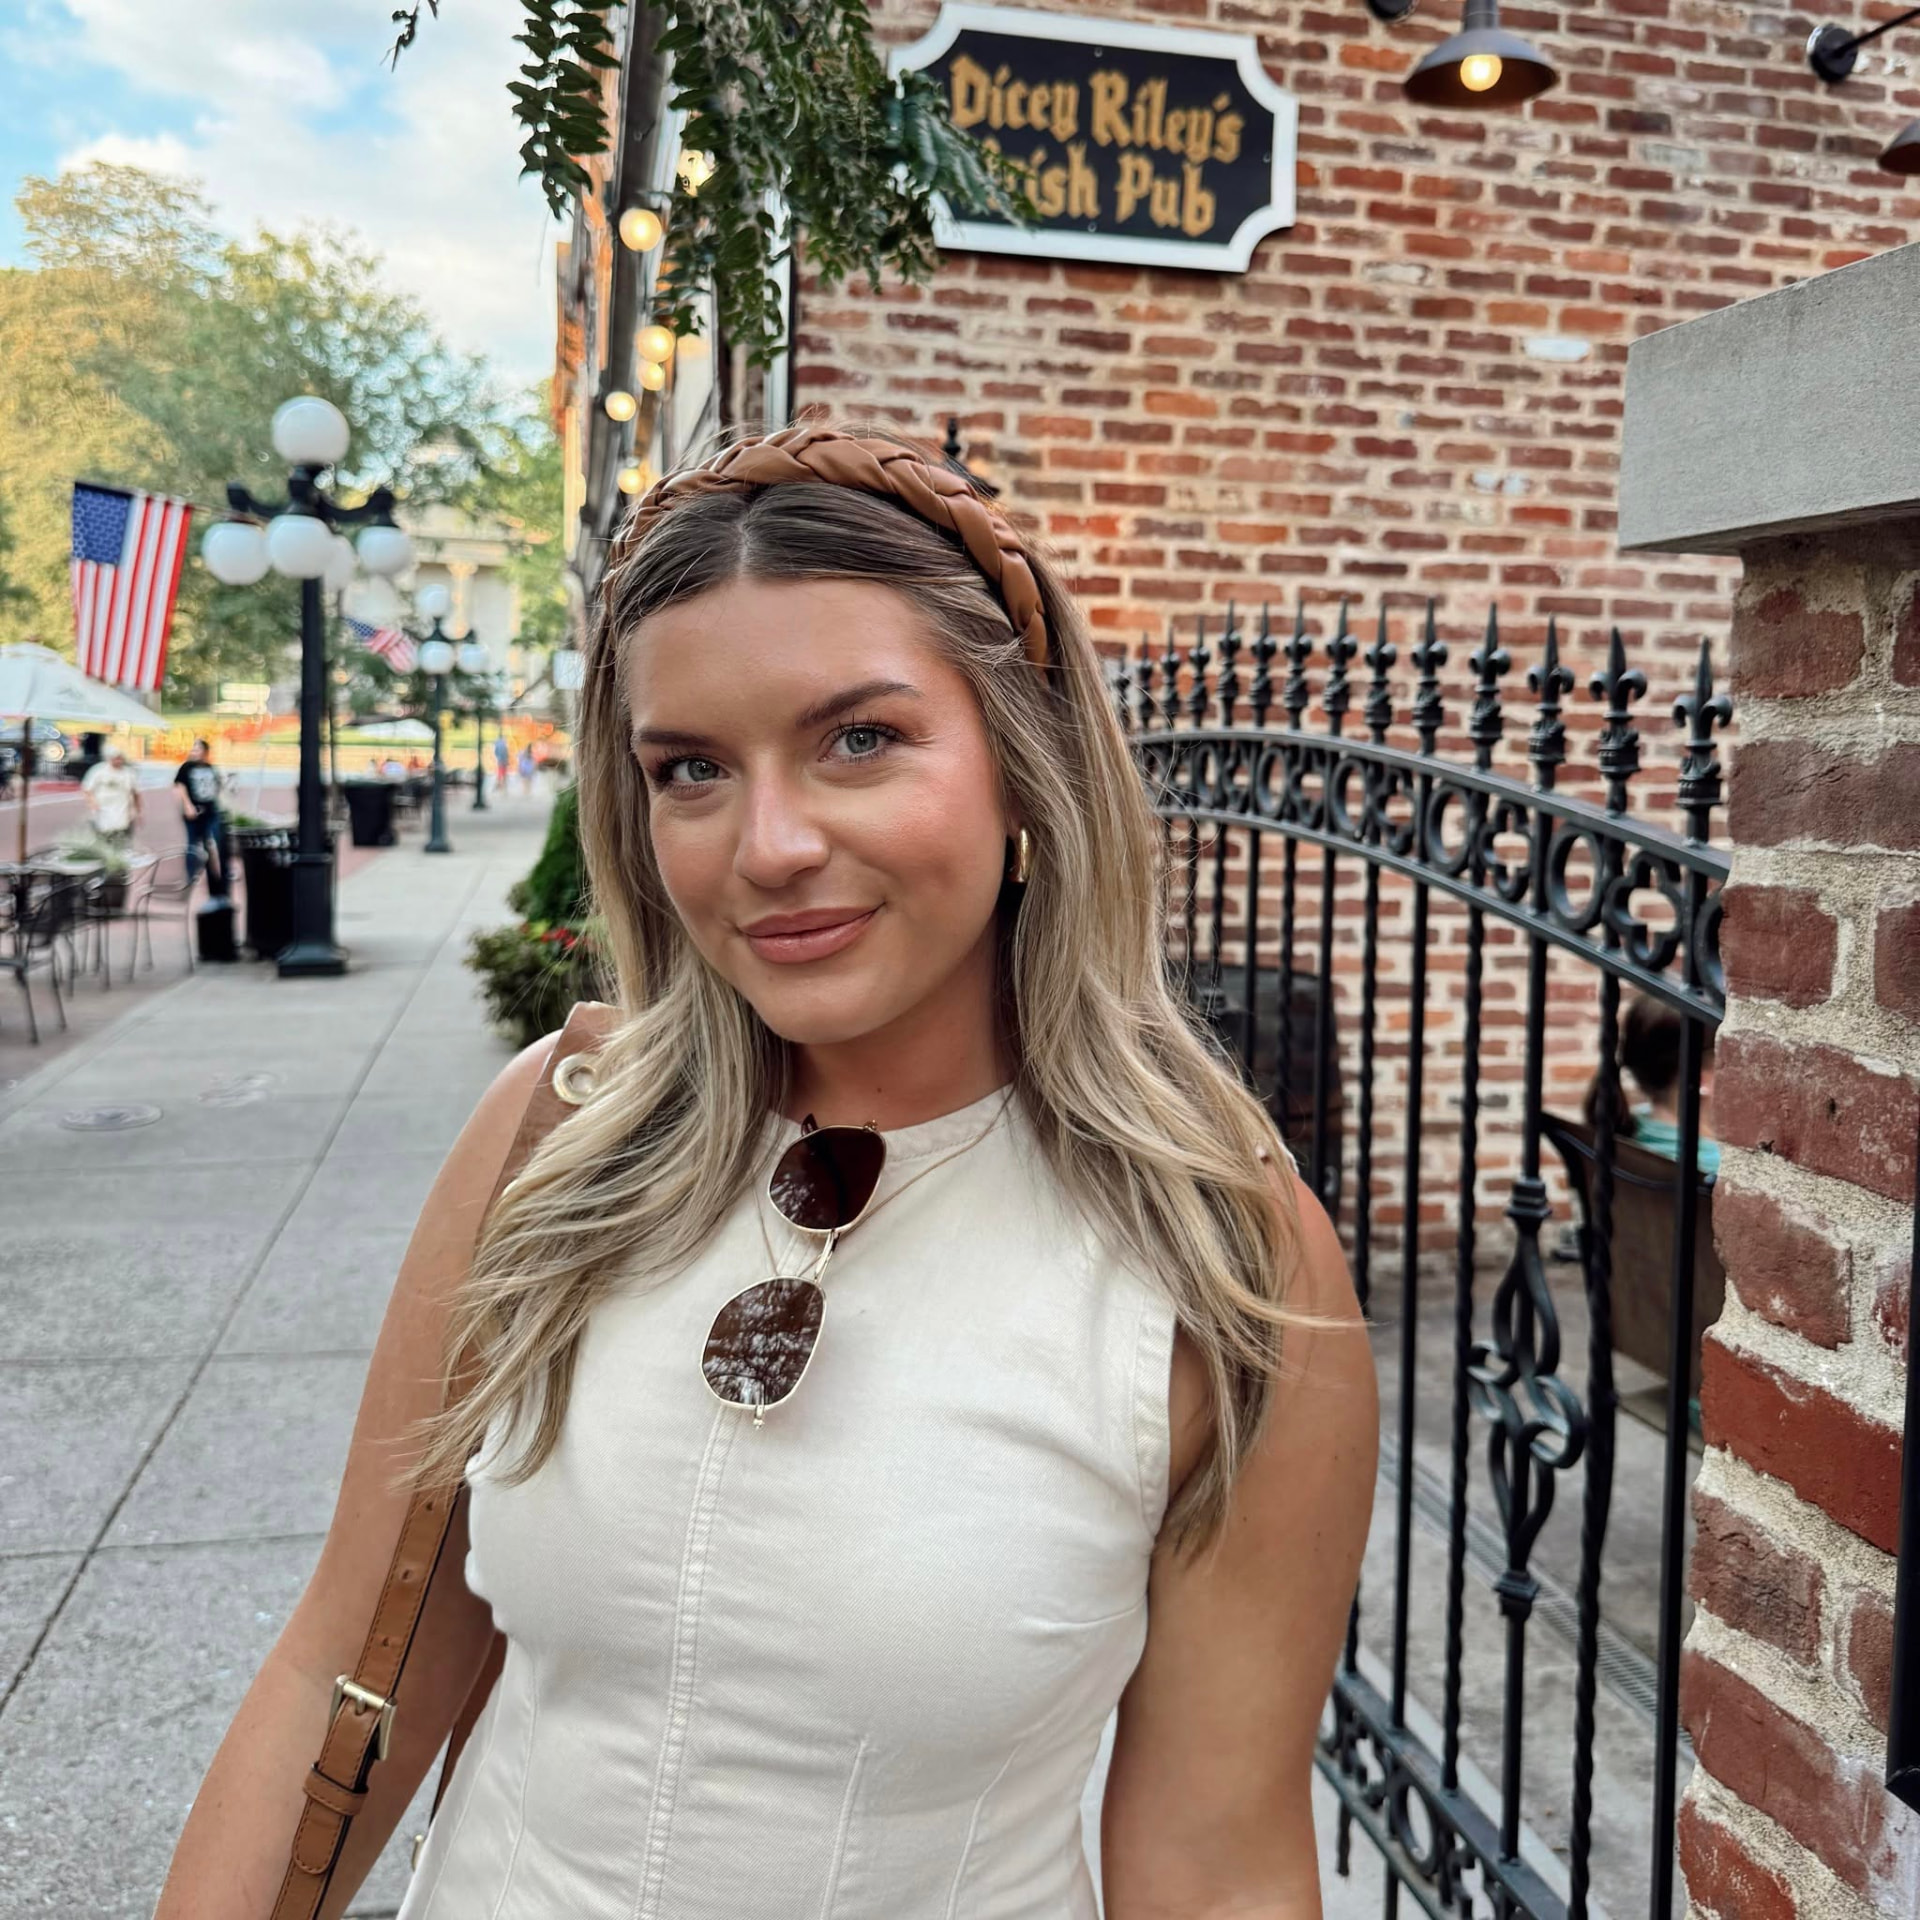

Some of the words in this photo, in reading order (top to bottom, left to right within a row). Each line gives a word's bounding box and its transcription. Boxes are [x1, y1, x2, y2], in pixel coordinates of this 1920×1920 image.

[949, 53, 1079, 143] Dicey
[1089, 69, 1245, 164] Riley's
[1115, 152, 1216, 238] Pub
